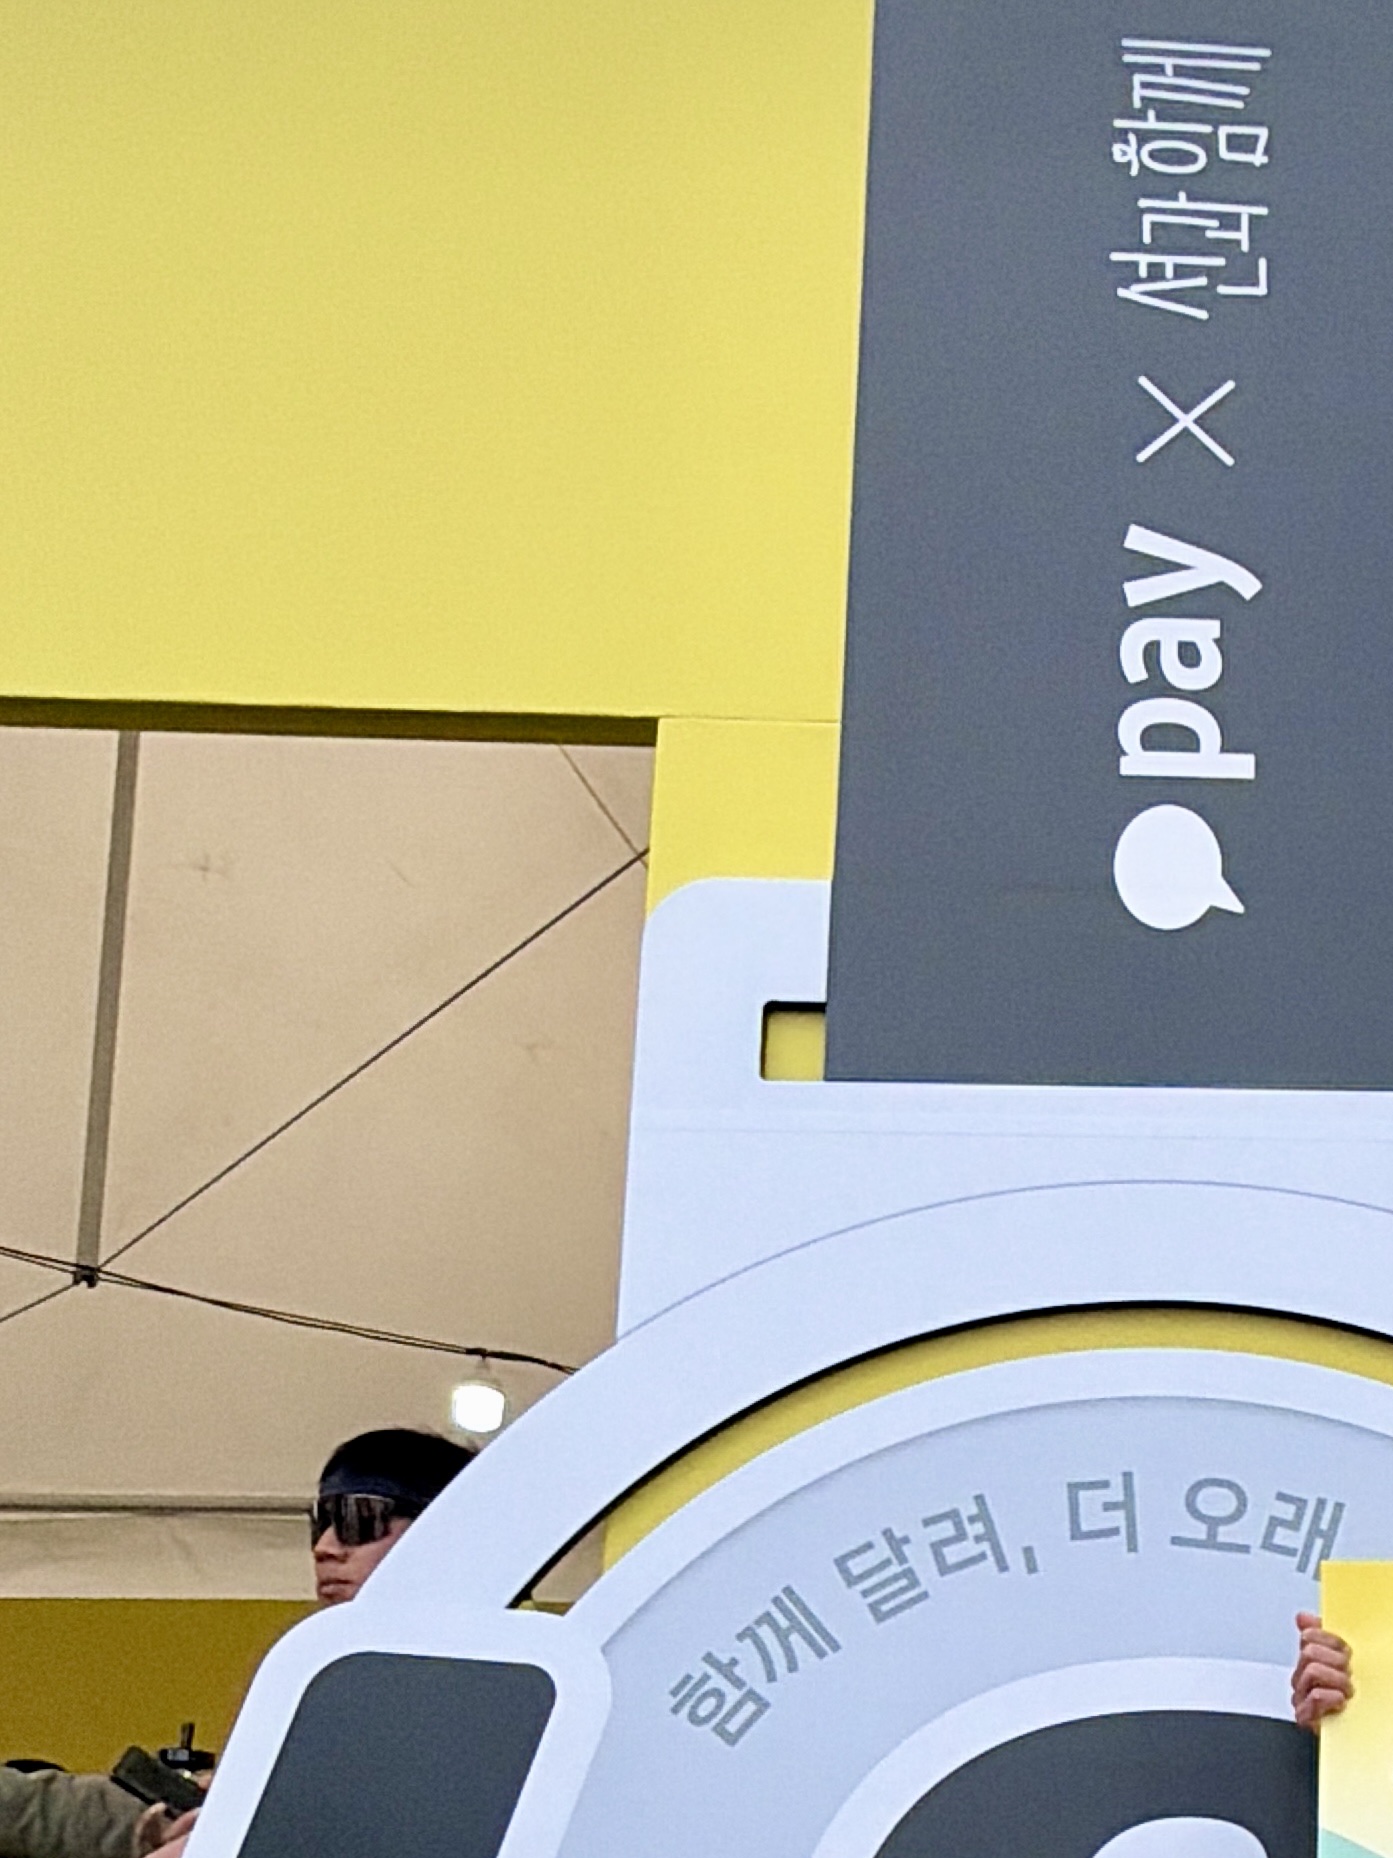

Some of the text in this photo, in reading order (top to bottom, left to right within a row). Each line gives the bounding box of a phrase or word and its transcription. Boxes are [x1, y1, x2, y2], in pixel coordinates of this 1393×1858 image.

[1112, 36, 1272, 176] 함께
[1116, 523, 1263, 780] pay
[668, 1470, 1346, 1747] 함께 달려, 더 오래
